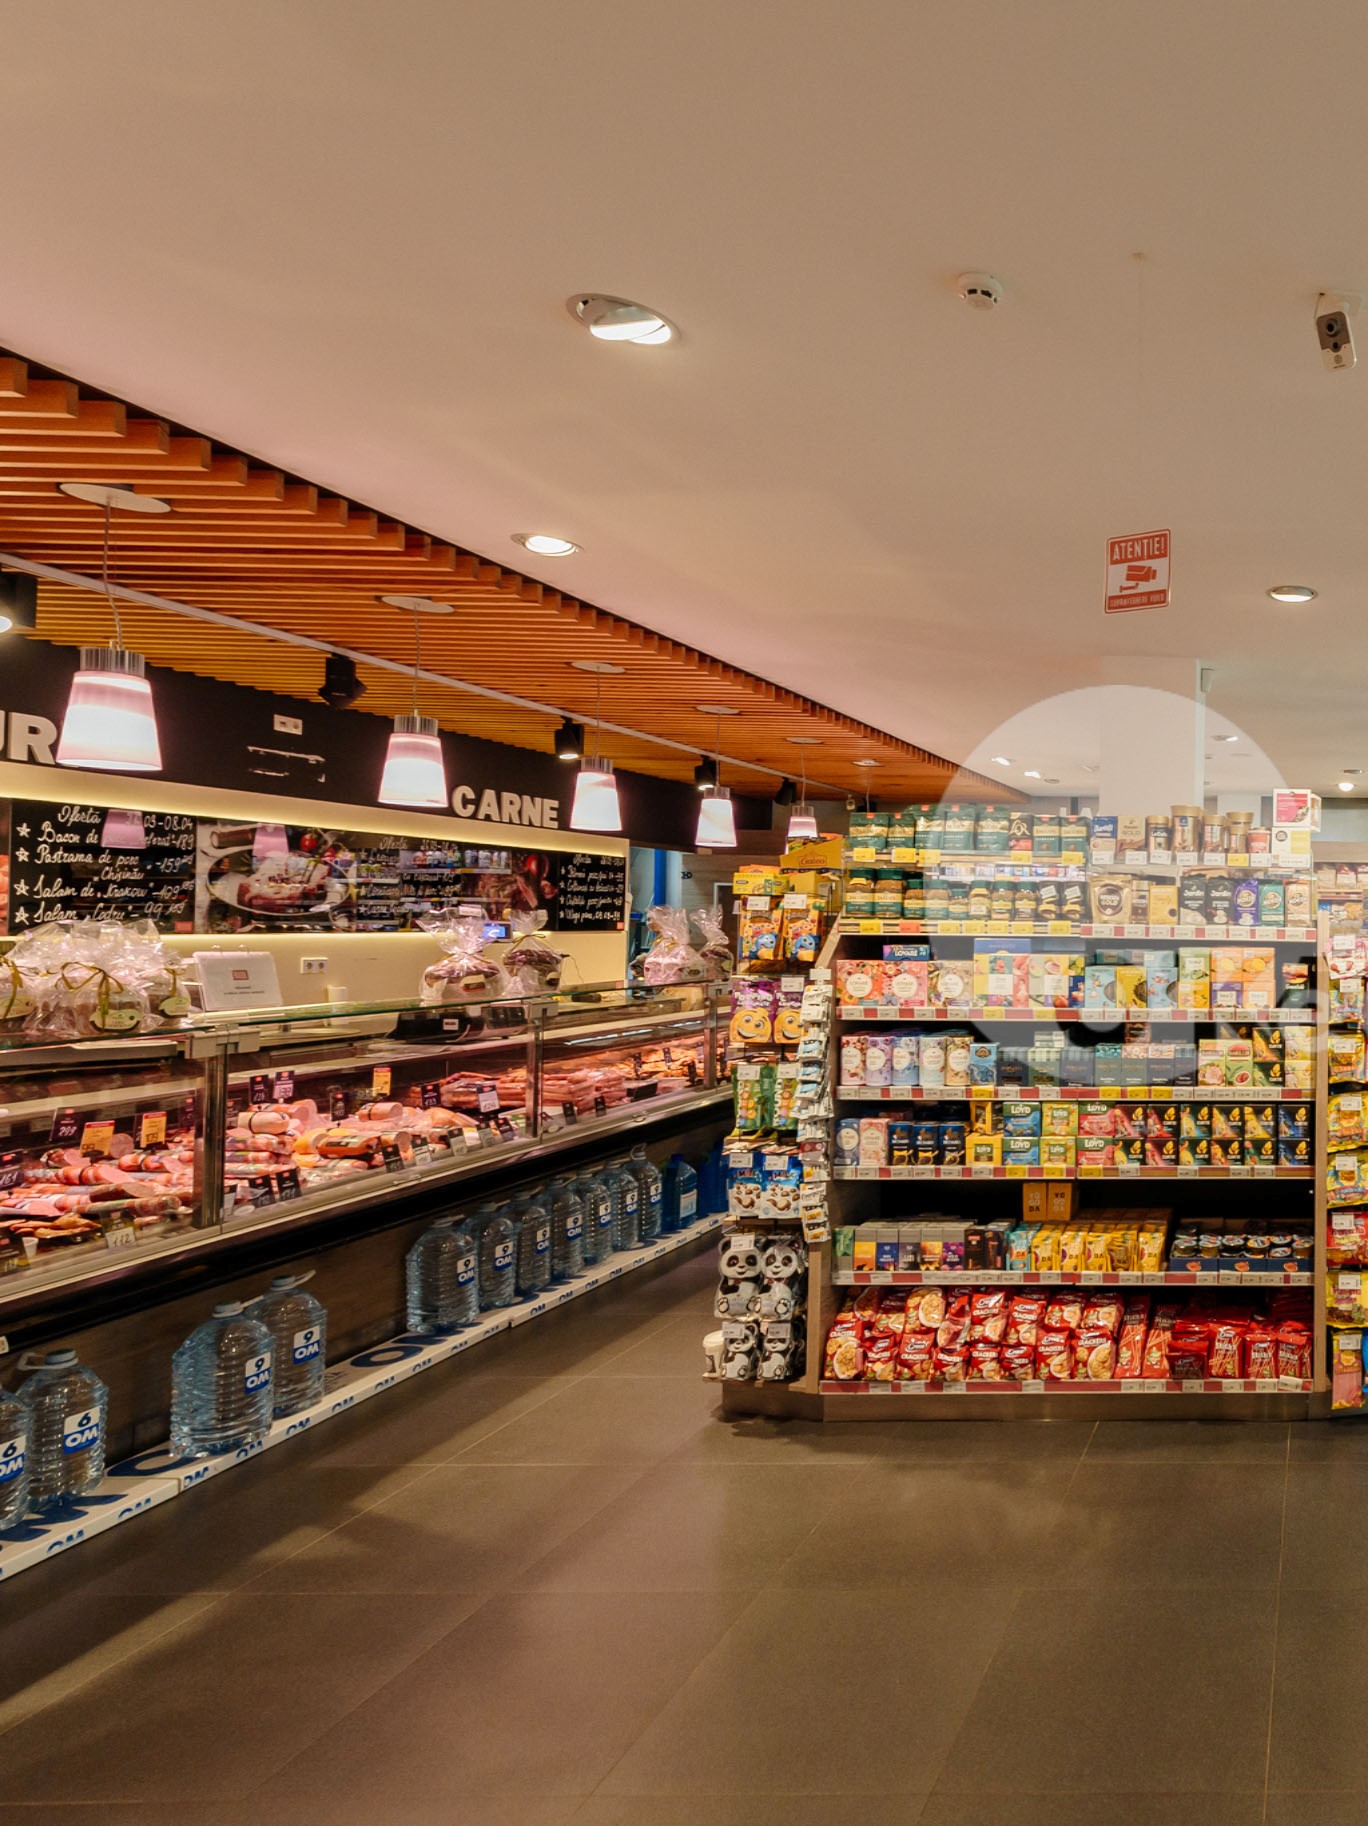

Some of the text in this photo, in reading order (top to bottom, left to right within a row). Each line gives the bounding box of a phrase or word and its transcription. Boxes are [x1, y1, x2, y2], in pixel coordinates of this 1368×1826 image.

[452, 785, 559, 829] CARNE
[495, 1256, 512, 1267] OM
[458, 1270, 475, 1282] OM
[304, 1330, 314, 1343] 9
[295, 1341, 319, 1361] OM
[255, 1357, 265, 1371] 9
[246, 1369, 271, 1389] OM
[78, 1412, 91, 1427] 6
[65, 1425, 98, 1448] OM
[3, 1443, 17, 1458] 6
